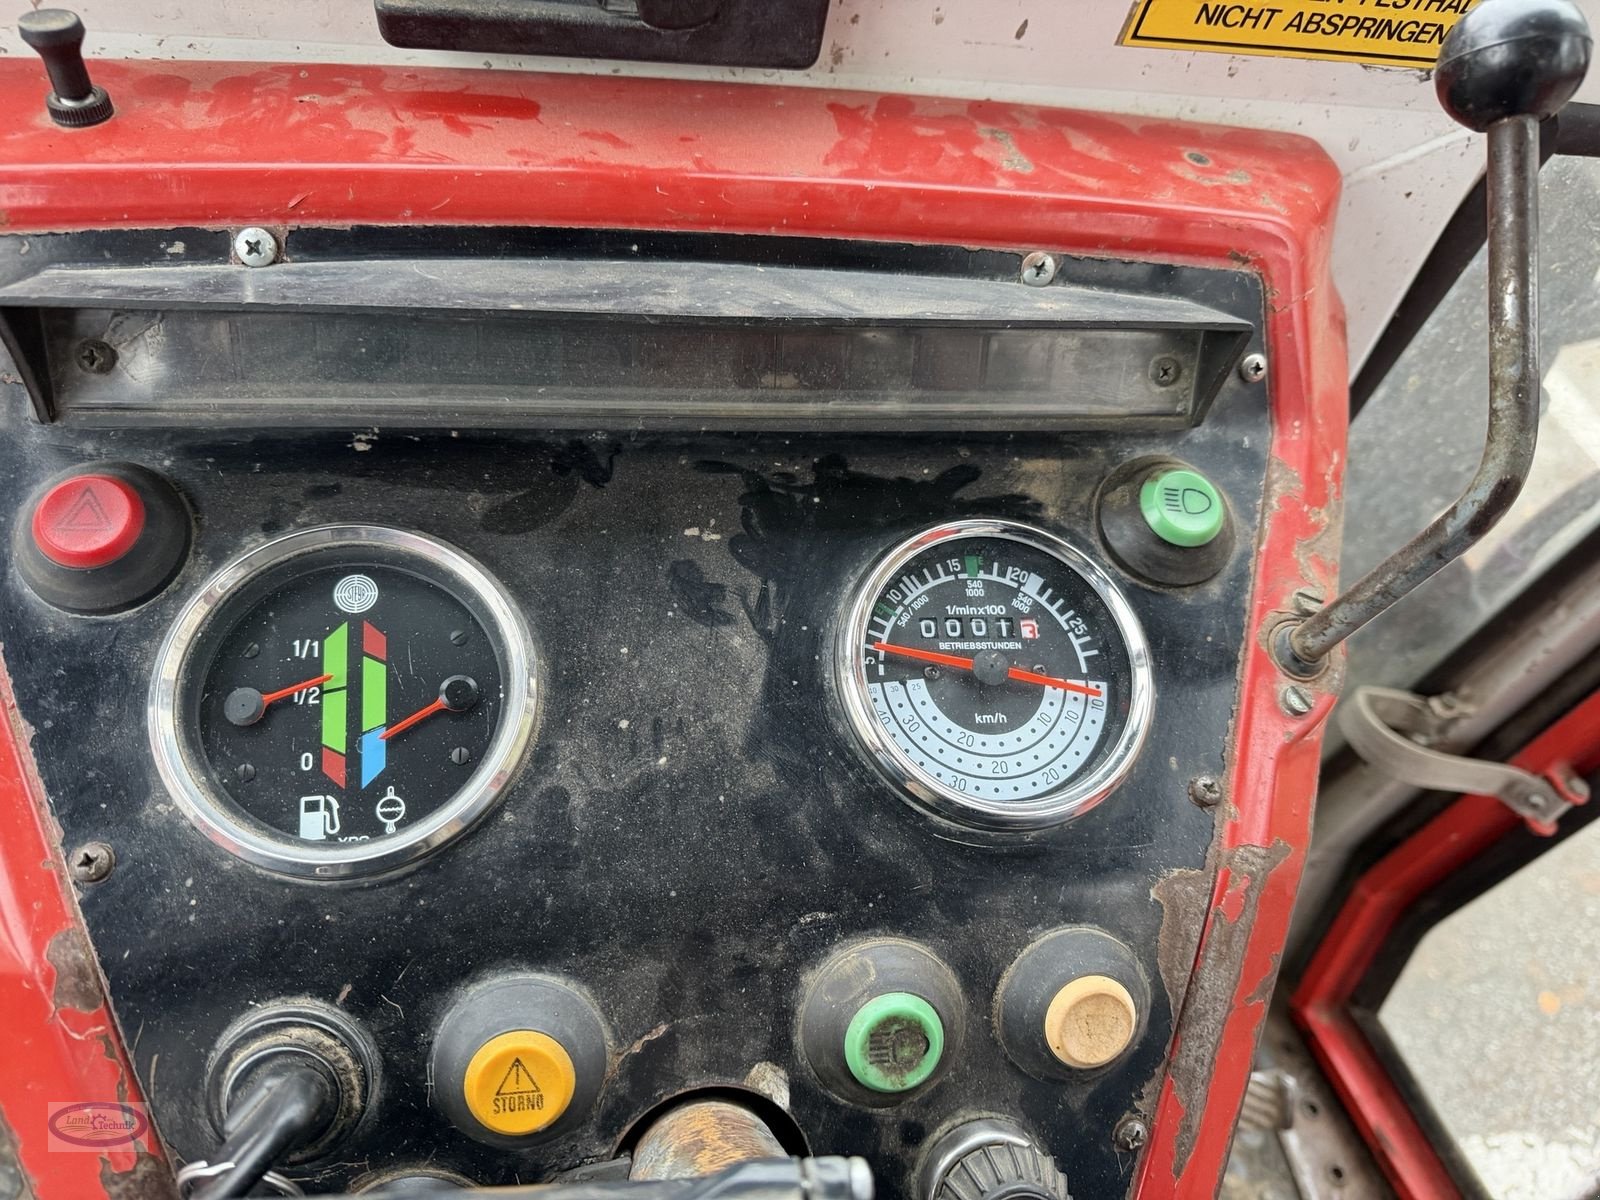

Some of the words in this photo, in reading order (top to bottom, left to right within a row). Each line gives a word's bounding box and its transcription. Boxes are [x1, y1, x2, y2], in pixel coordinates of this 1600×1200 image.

[1194, 3, 1283, 30] NICHT
[1283, 11, 1454, 45] ABSPRINGEN
[946, 558, 961, 572] 15
[1011, 567, 1029, 583] 20
[966, 580, 983, 588] 540
[886, 589, 902, 604] 10
[965, 588, 985, 597] 1000
[1017, 592, 1033, 606] 540
[1011, 599, 1030, 614] 1000
[1068, 617, 1088, 635] 25
[293, 639, 319, 659] 1/1
[939, 642, 1022, 651] BETRIEBSSTUNDEN
[911, 683, 921, 691] 25
[1091, 699, 1104, 711] 10
[902, 714, 920, 732] 30
[974, 713, 1007, 724] km/h
[1037, 712, 1052, 727] 10
[1065, 710, 1079, 724] 10
[957, 731, 975, 747] 20
[301, 752, 313, 771] 0
[991, 761, 1009, 774] 20
[949, 775, 966, 792] 30
[1042, 768, 1059, 785] 20
[493, 1094, 544, 1115] STORNO
